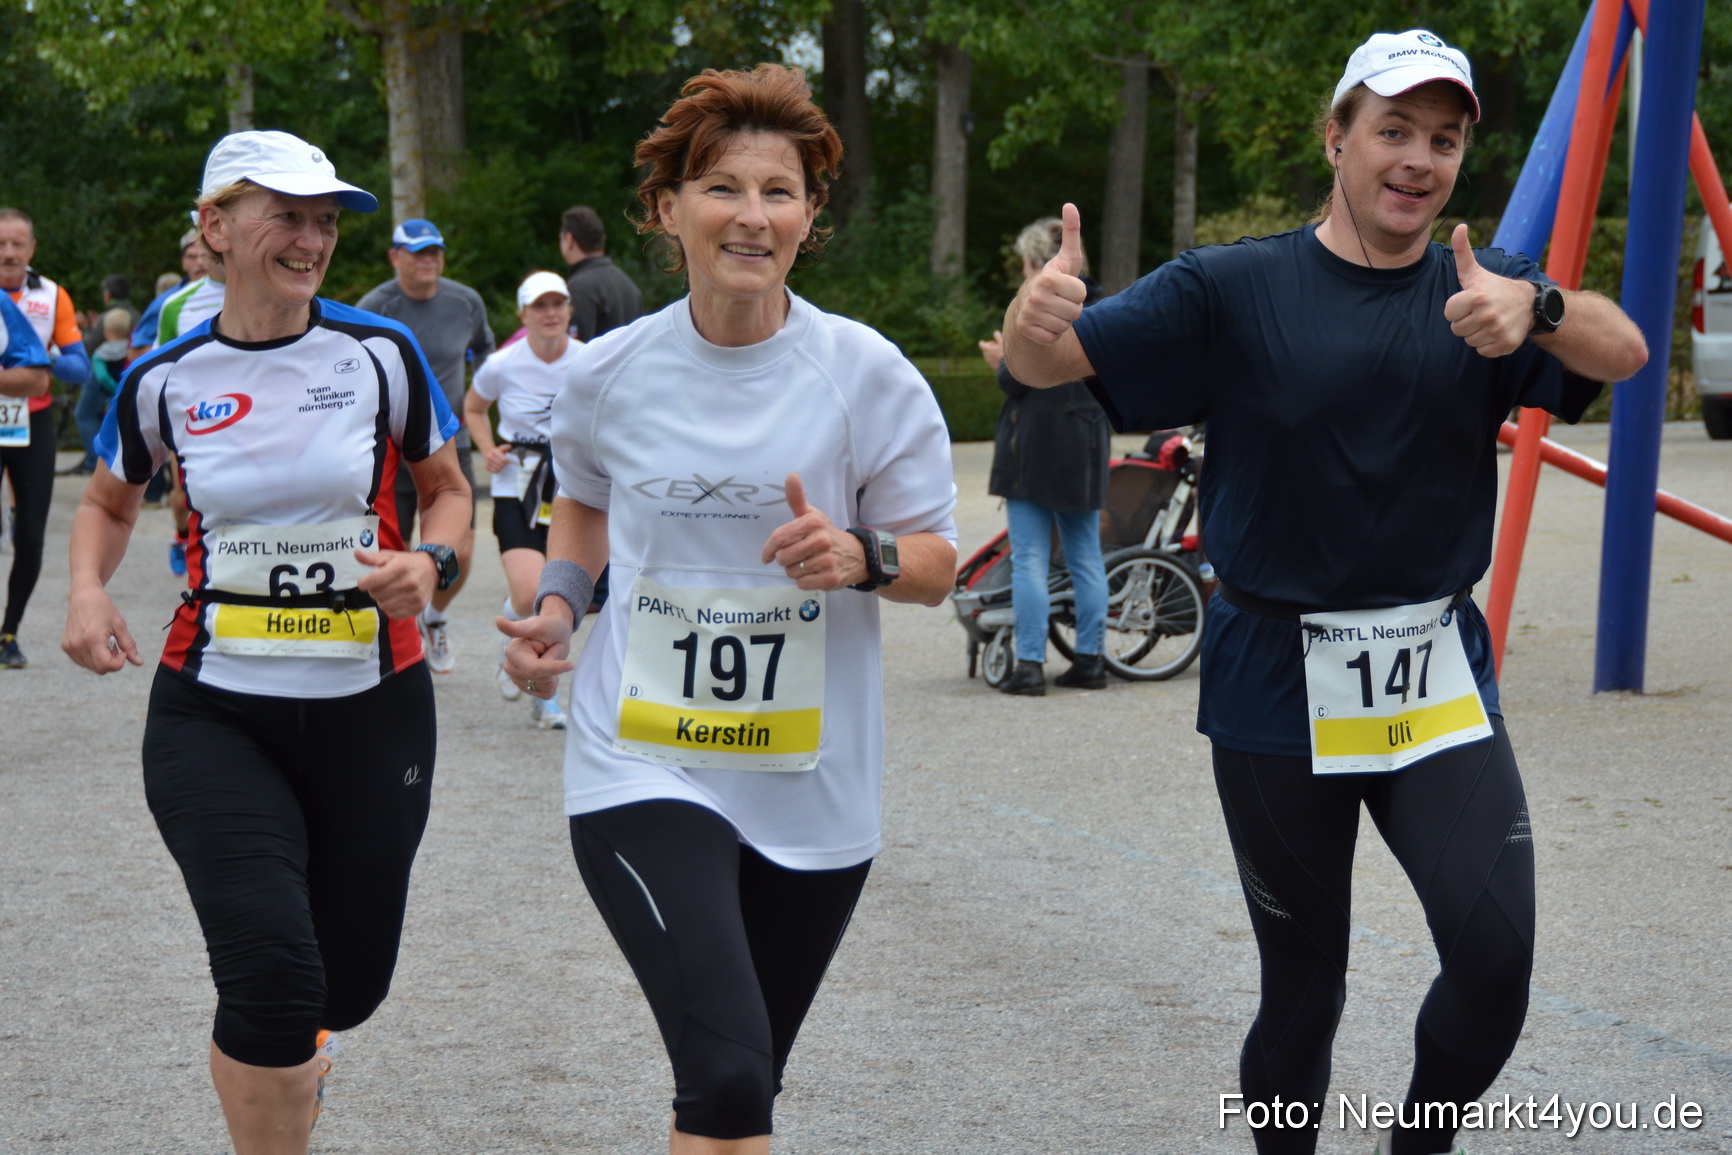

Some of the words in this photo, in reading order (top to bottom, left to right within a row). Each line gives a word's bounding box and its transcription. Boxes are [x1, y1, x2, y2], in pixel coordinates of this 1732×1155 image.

[1388, 49, 1417, 60] BMW
[306, 385, 331, 395] team
[314, 390, 355, 402] klinikum
[186, 402, 232, 422] tkn
[298, 401, 344, 413] nürnberg
[218, 541, 272, 555] PARTL
[277, 536, 354, 555] Neumarkt
[269, 562, 335, 598] 63
[637, 596, 692, 623] PARTL
[697, 606, 791, 624] Neumarkt
[266, 613, 330, 634] Heide
[1308, 626, 1367, 643] PARTL
[1372, 617, 1439, 640] Neumarkt
[673, 631, 785, 701] 197
[1346, 639, 1432, 708] 147
[629, 686, 638, 696] D
[1317, 706, 1325, 717] C
[676, 716, 770, 747] Kerstin
[1387, 720, 1413, 747] Uli
